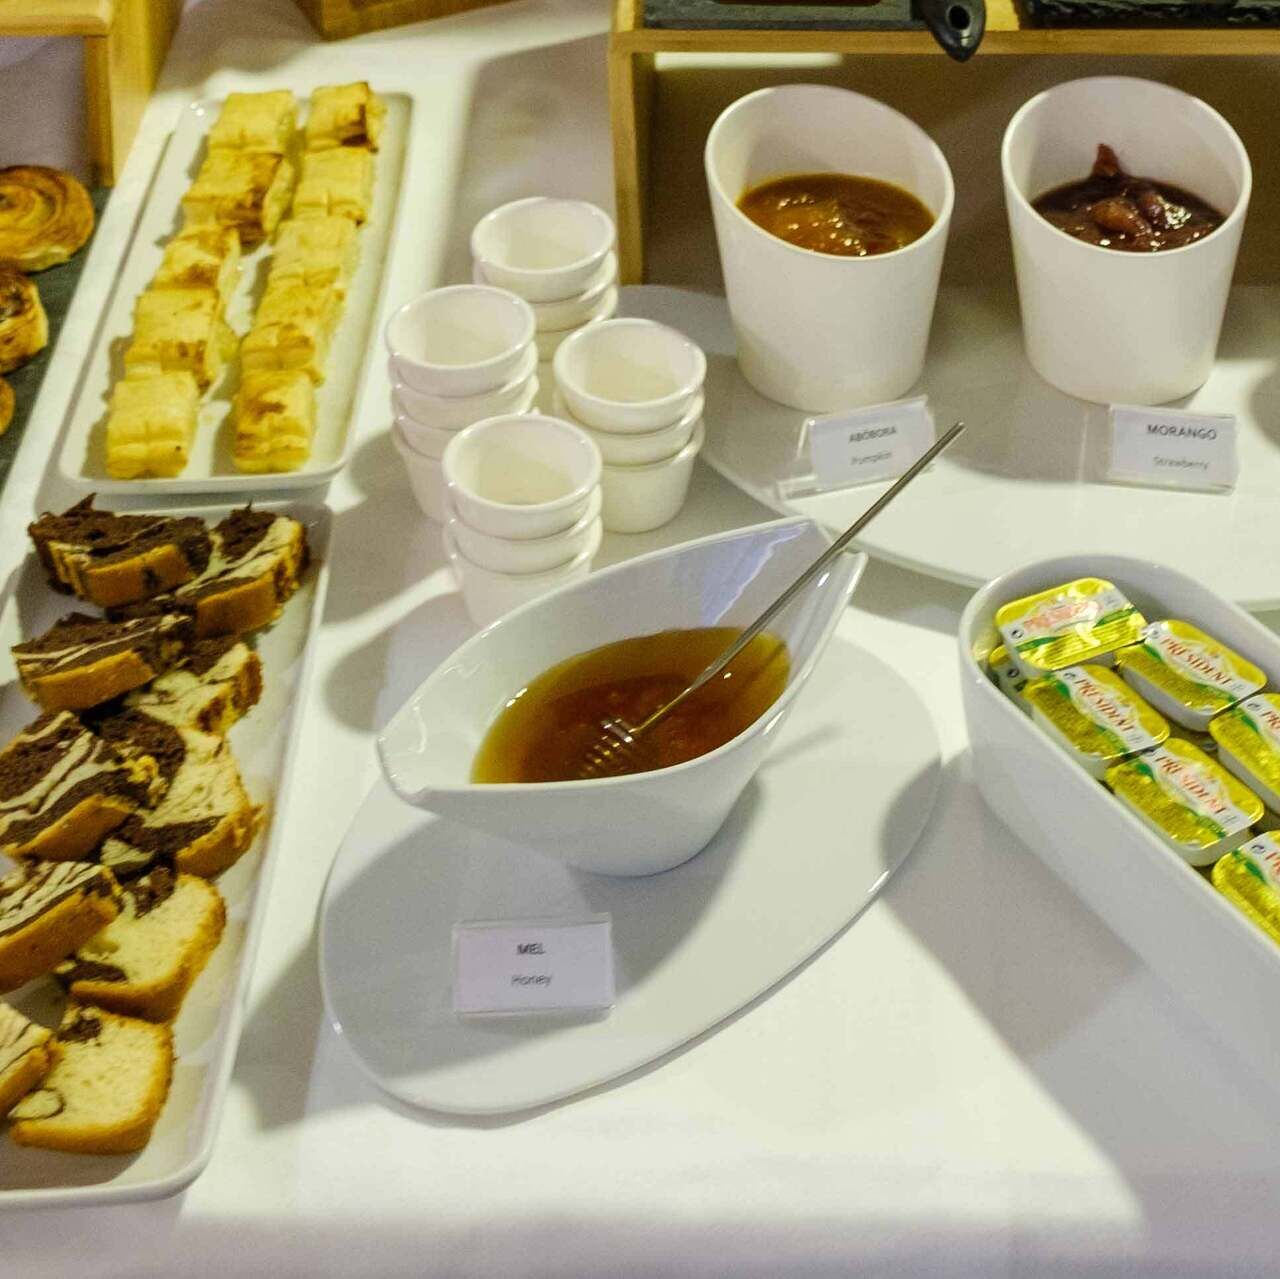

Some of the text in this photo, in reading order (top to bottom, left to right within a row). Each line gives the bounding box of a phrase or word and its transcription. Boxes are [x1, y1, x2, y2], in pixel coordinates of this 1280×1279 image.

[1147, 423, 1217, 441] MORANGO
[1153, 455, 1210, 471] Strawberry
[517, 942, 545, 956] MEL
[511, 974, 553, 987] Honey
